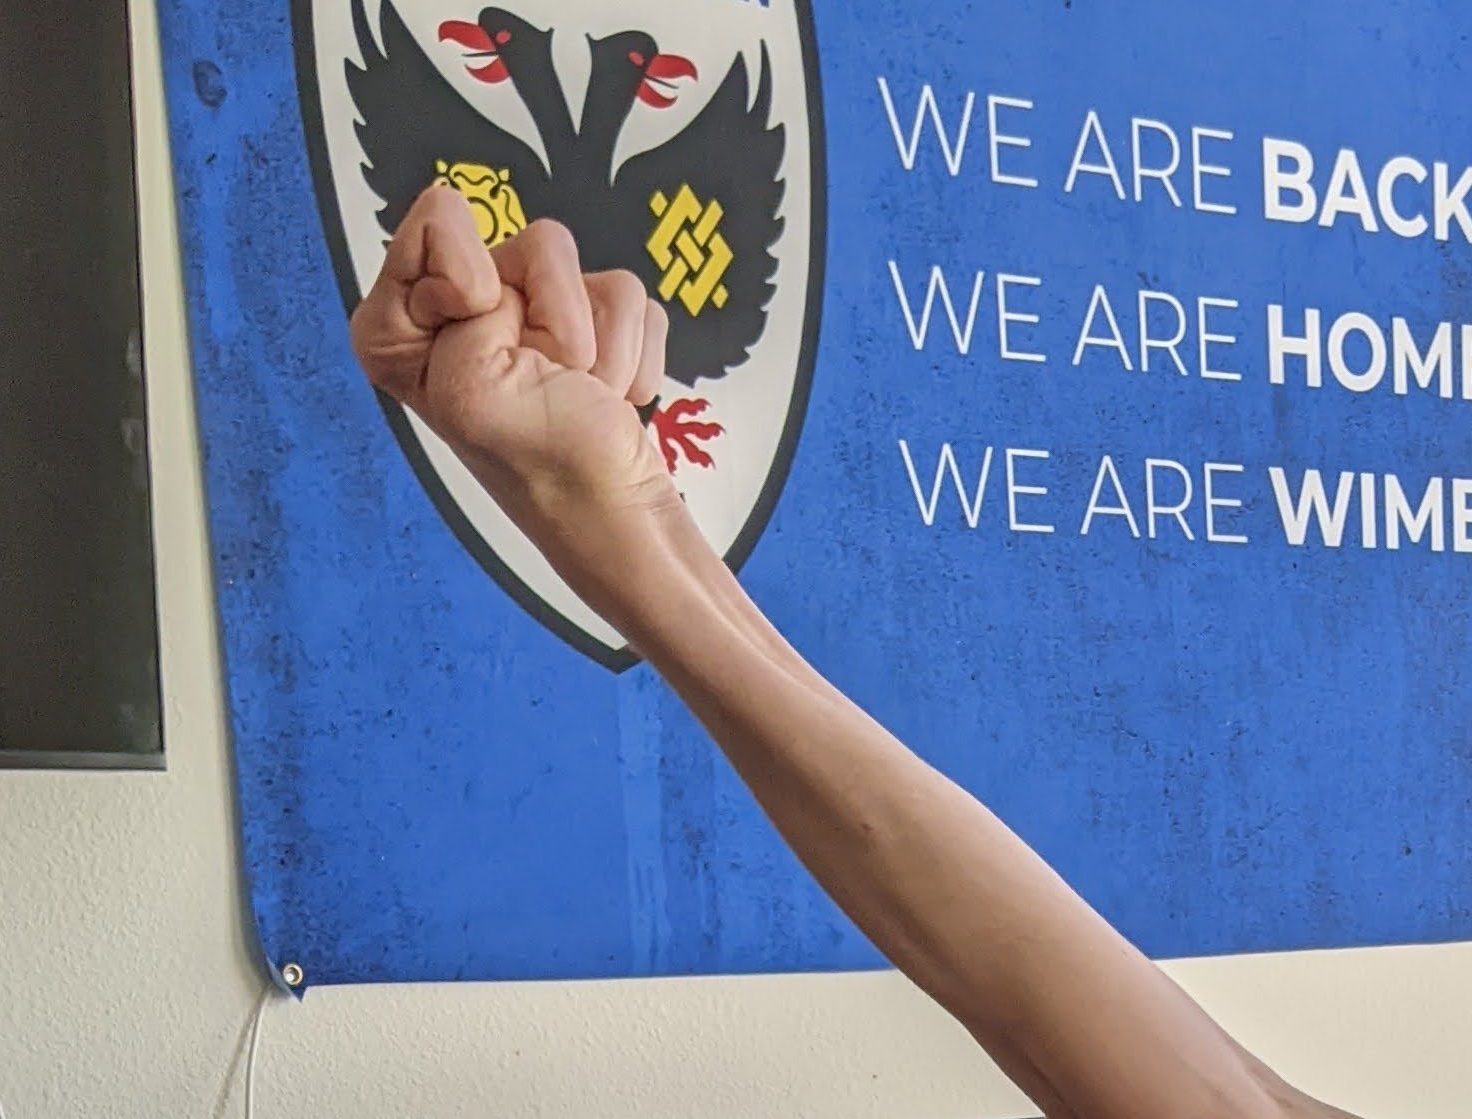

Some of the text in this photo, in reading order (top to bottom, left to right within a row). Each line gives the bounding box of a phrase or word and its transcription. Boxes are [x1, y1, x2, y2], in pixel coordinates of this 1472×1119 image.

[877, 77, 1039, 187] WE
[1064, 110, 1237, 215] ARE
[887, 260, 1046, 363] WE
[1072, 284, 1242, 381] ARE
[897, 439, 1056, 533] WE
[1080, 454, 1249, 544] ARE
